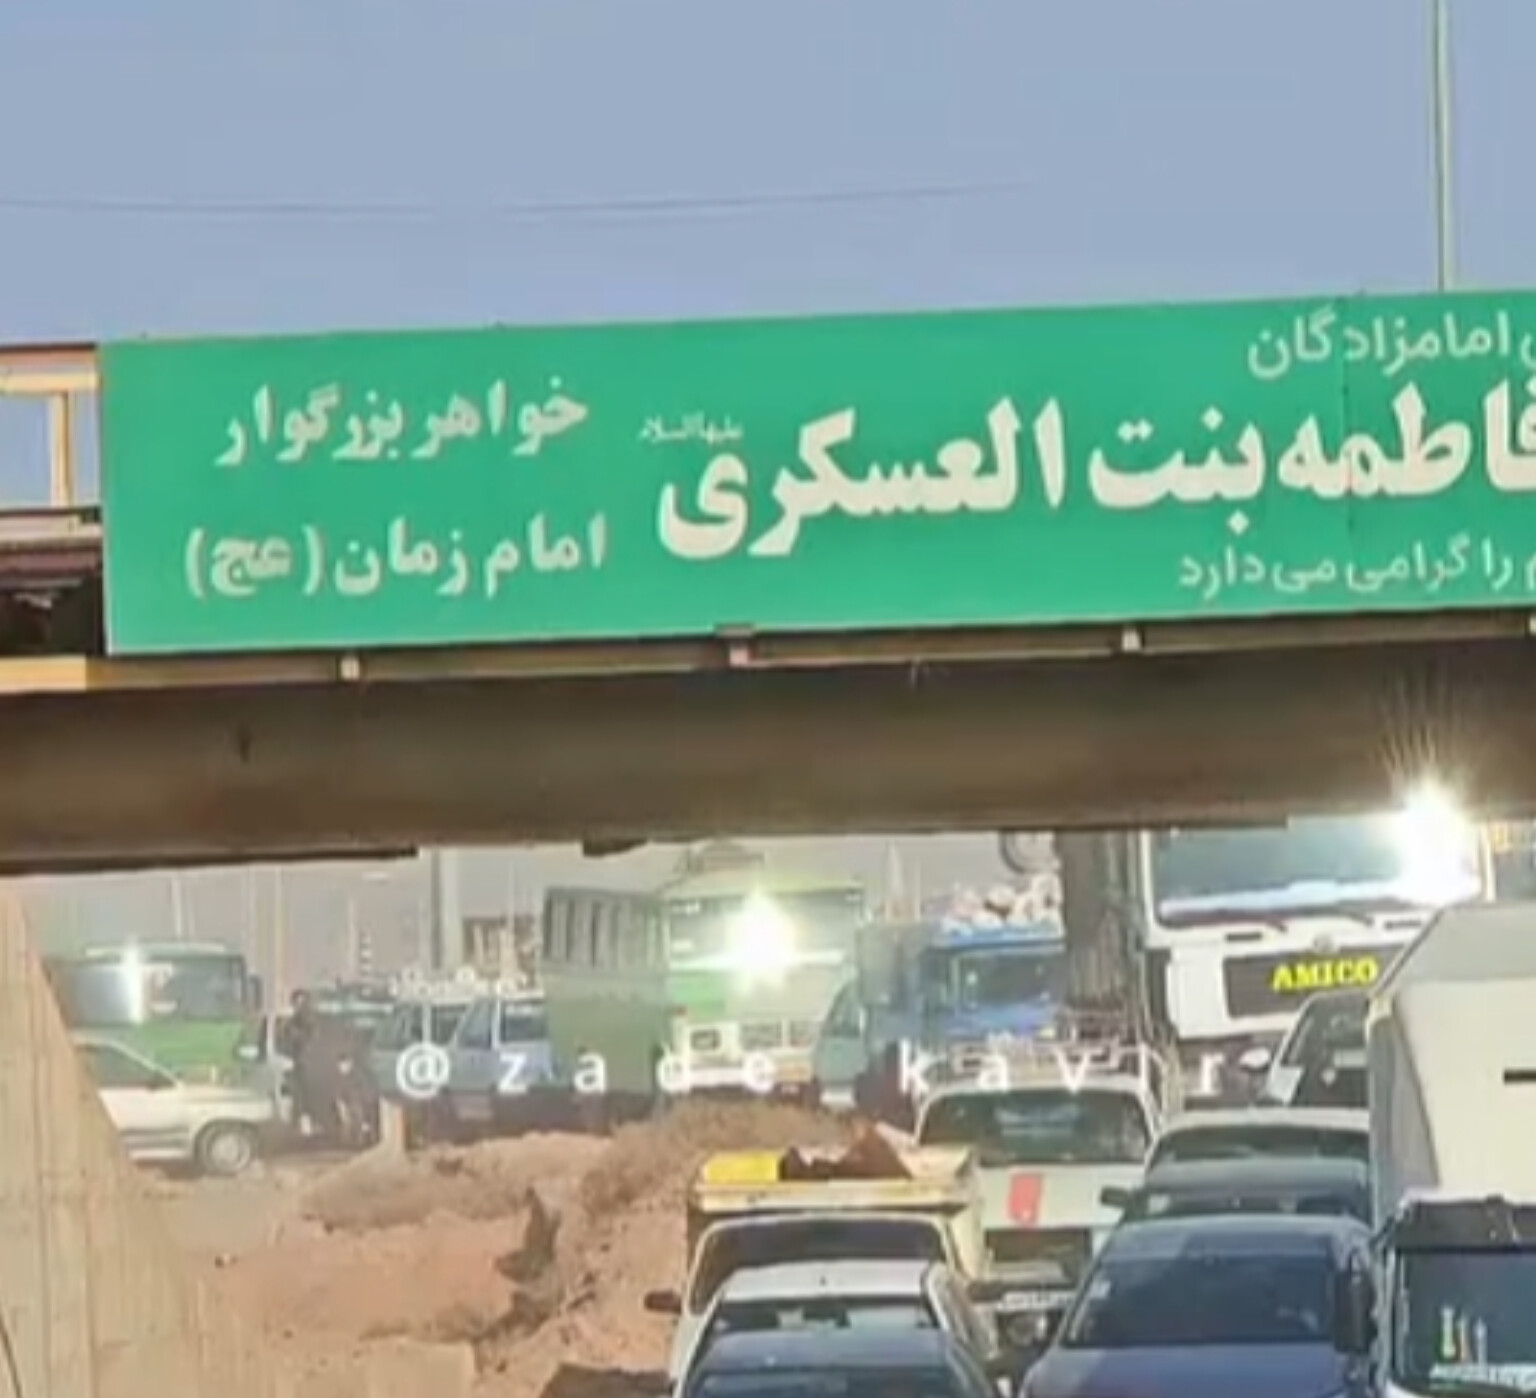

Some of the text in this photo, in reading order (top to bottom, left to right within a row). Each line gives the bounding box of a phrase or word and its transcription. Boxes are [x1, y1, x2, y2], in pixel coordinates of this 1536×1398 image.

[1247, 304, 1511, 379] امامزادگان
[216, 376, 589, 467] خواهر بزرگوار
[657, 395, 1067, 561] العسکری
[1086, 406, 1268, 536] بنت
[184, 512, 608, 600] امام زمان (عج)
[1344, 532, 1471, 594] گرامی
[1481, 539, 1513, 591] را
[1272, 957, 1380, 994] AMICO
